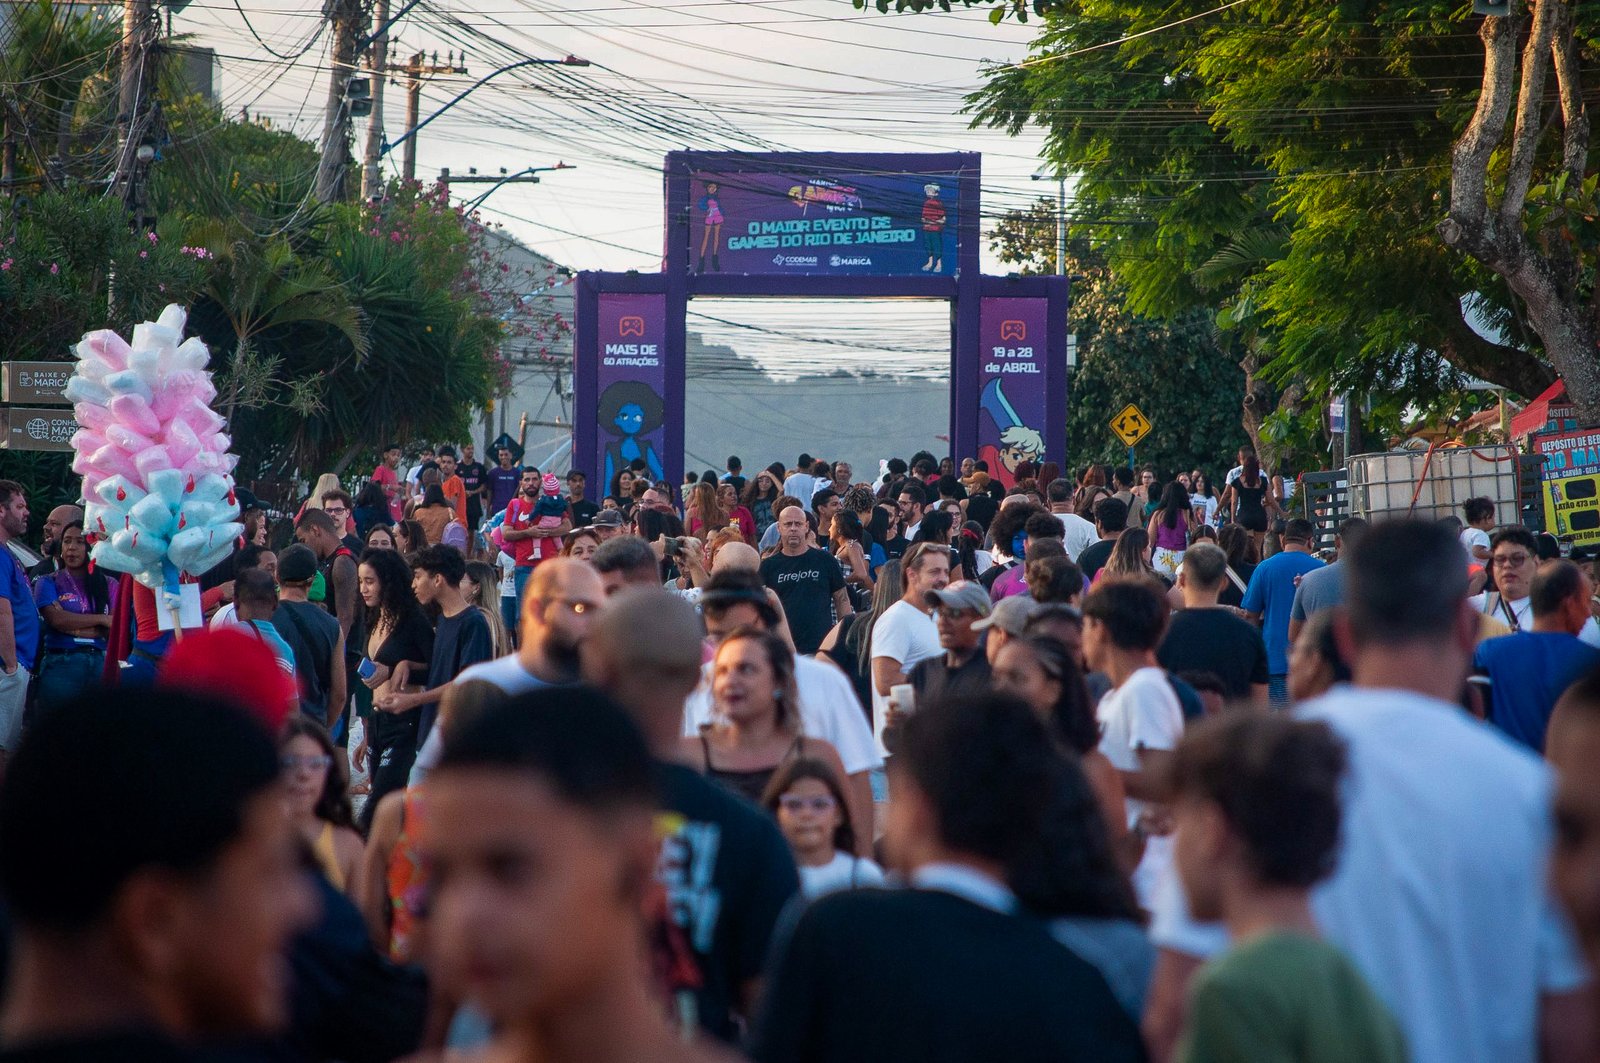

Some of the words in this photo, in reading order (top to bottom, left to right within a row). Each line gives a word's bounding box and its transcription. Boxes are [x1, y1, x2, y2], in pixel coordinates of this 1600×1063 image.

[748, 222, 759, 235] O
[762, 220, 810, 234] MAIOR
[813, 217, 869, 232] EVENTO
[871, 216, 892, 229] DE
[727, 235, 779, 250] GAMES
[781, 234, 803, 247] DO
[805, 232, 831, 246] RIO
[833, 232, 853, 245] DE
[855, 229, 916, 244] JANEIRO
[605, 344, 638, 355] MAIS
[640, 344, 657, 355] DE
[992, 347, 1006, 357] 19
[1007, 349, 1016, 357] a
[1017, 347, 1033, 358] 28
[603, 357, 616, 366] 60
[616, 356, 659, 367] ATRAÇÕES
[985, 362, 1000, 373] de
[1002, 362, 1041, 373] ABRIL
[1548, 408, 1569, 417] ÓSITO
[51, 419, 78, 427] CONHE
[1541, 437, 1577, 452] DEPÓSITO
[1577, 436, 1587, 447] DE
[1576, 499, 1588, 508] 473
[777, 569, 820, 584] Errejota
